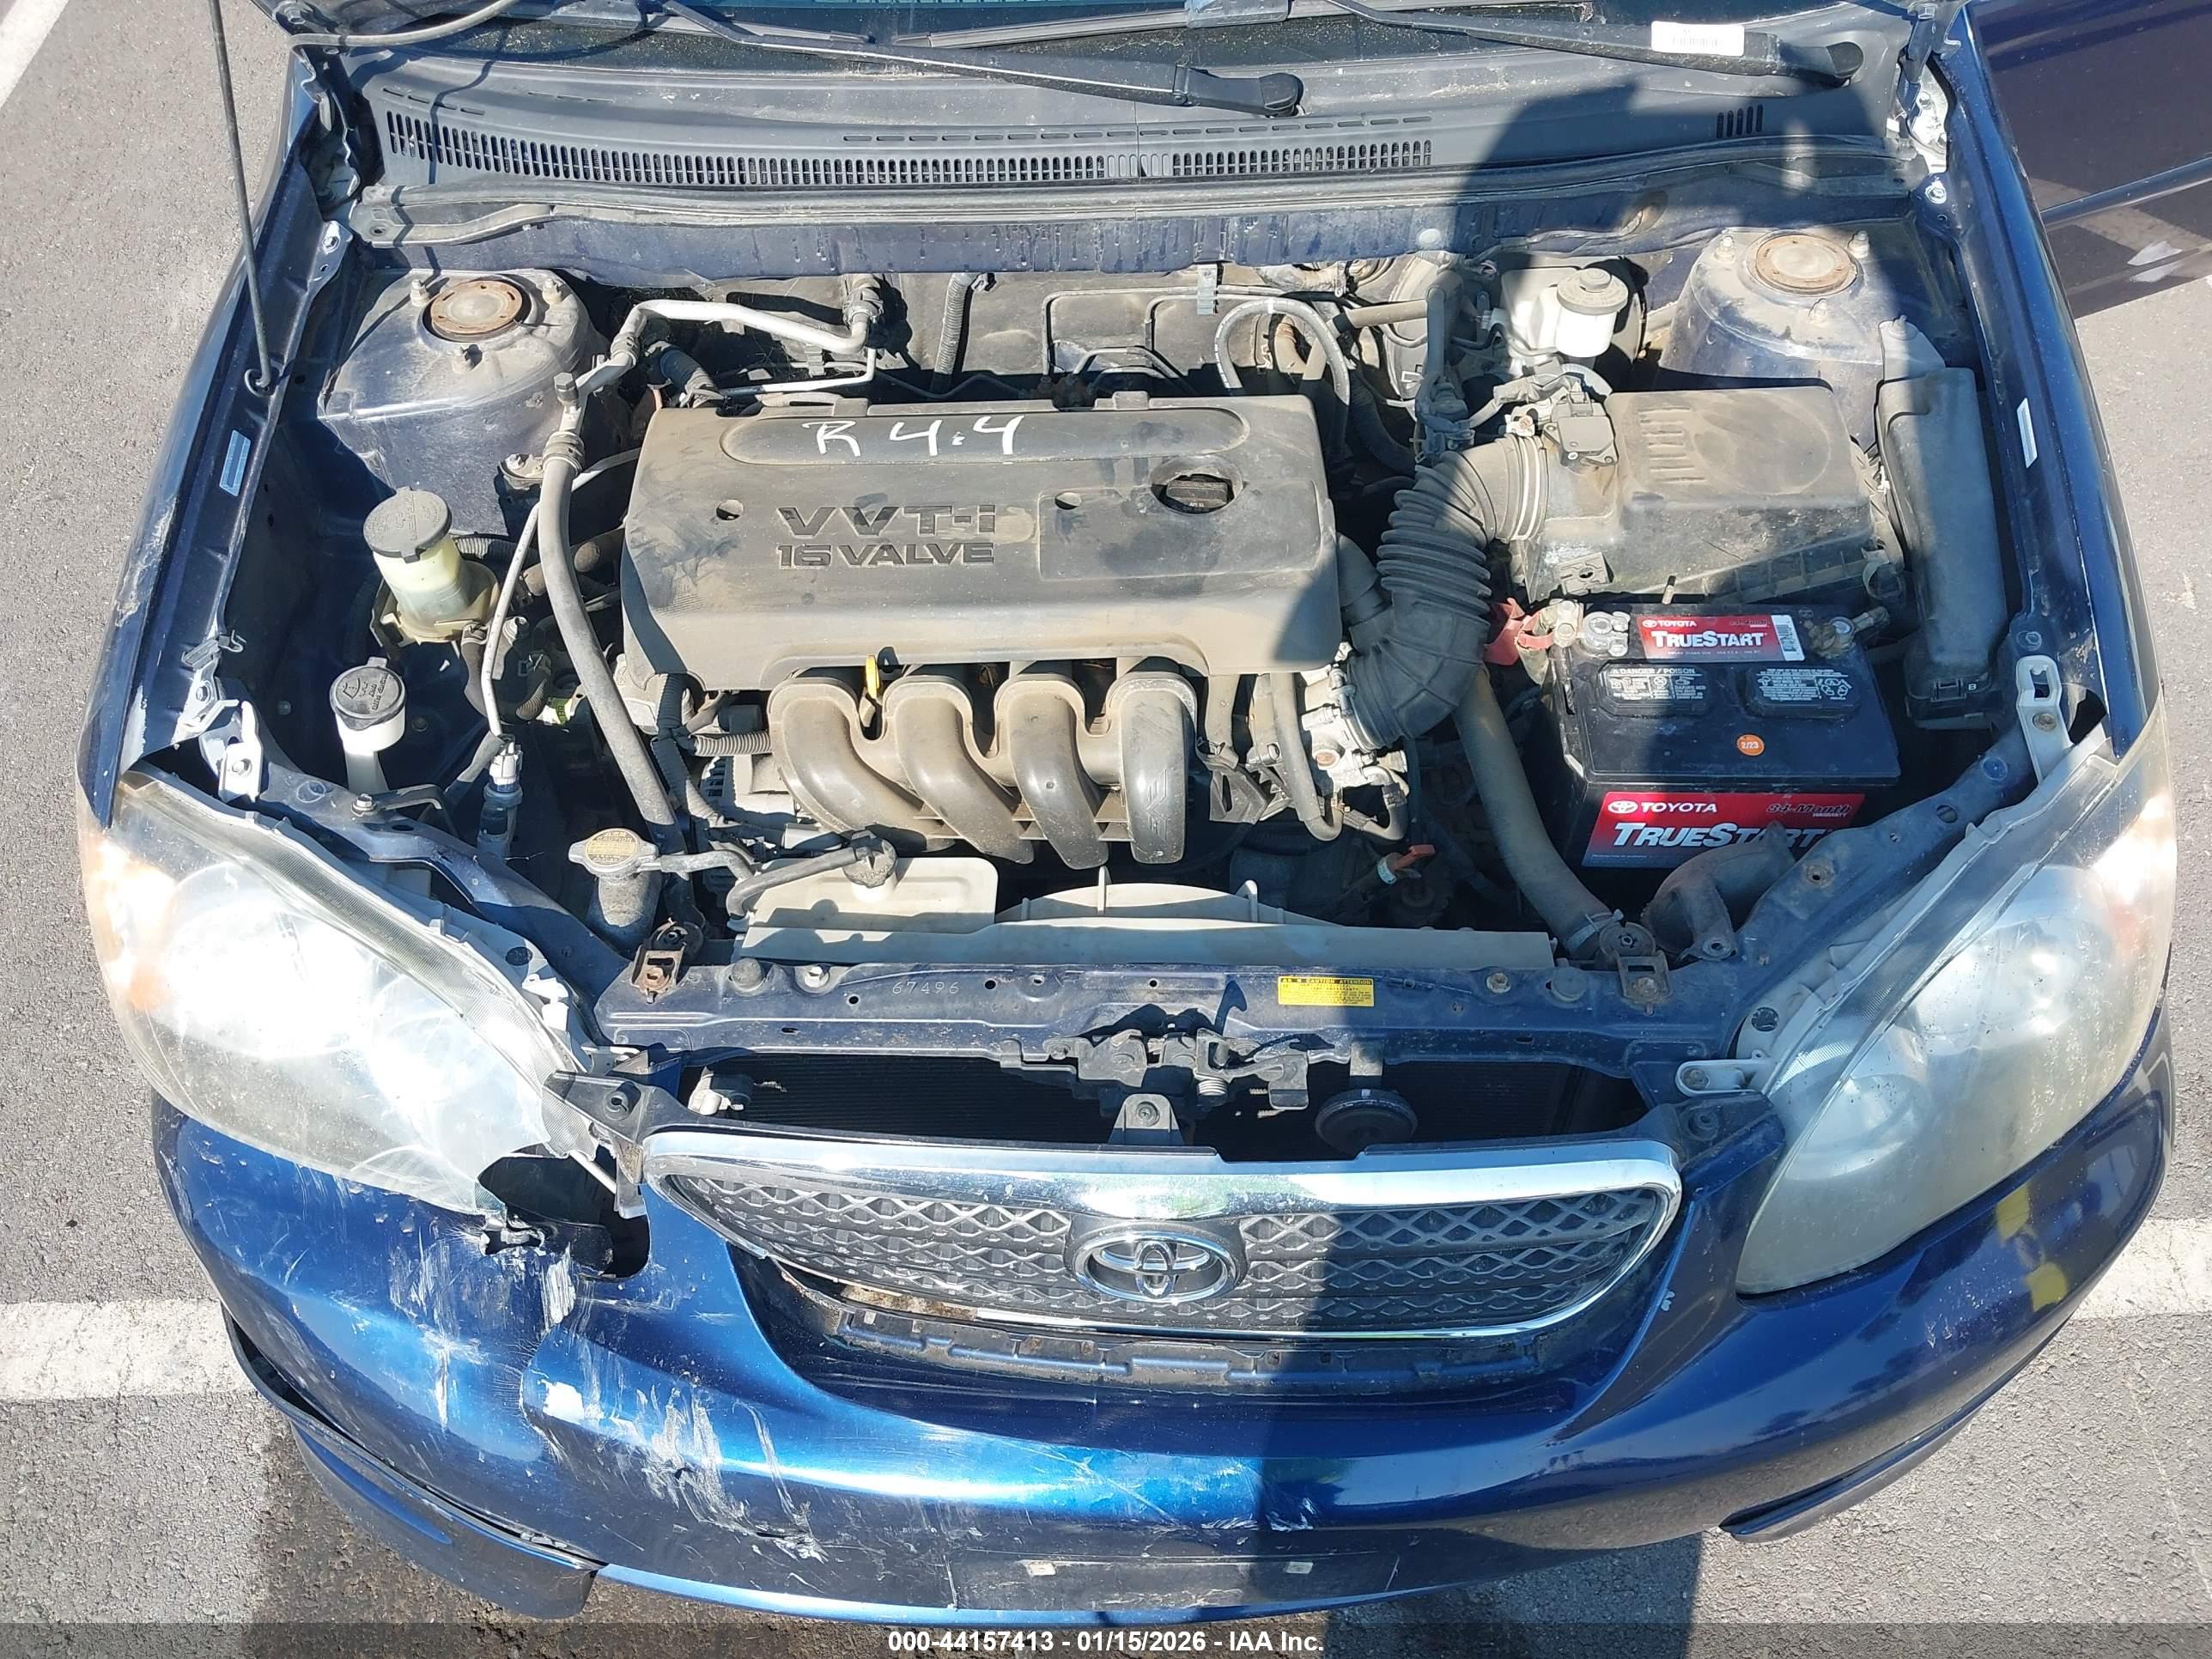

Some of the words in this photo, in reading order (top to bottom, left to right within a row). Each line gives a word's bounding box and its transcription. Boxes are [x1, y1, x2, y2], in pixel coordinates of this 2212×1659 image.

[802, 420, 860, 457] R
[776, 503, 996, 538] VVT-i
[776, 544, 832, 568] 16
[837, 542, 995, 568] VALVE
[1658, 619, 1698, 628] TOYOTA
[1741, 741, 1759, 750] 2/23
[1640, 802, 1718, 813] TOYOTA
[892, 981, 959, 994] 67496
